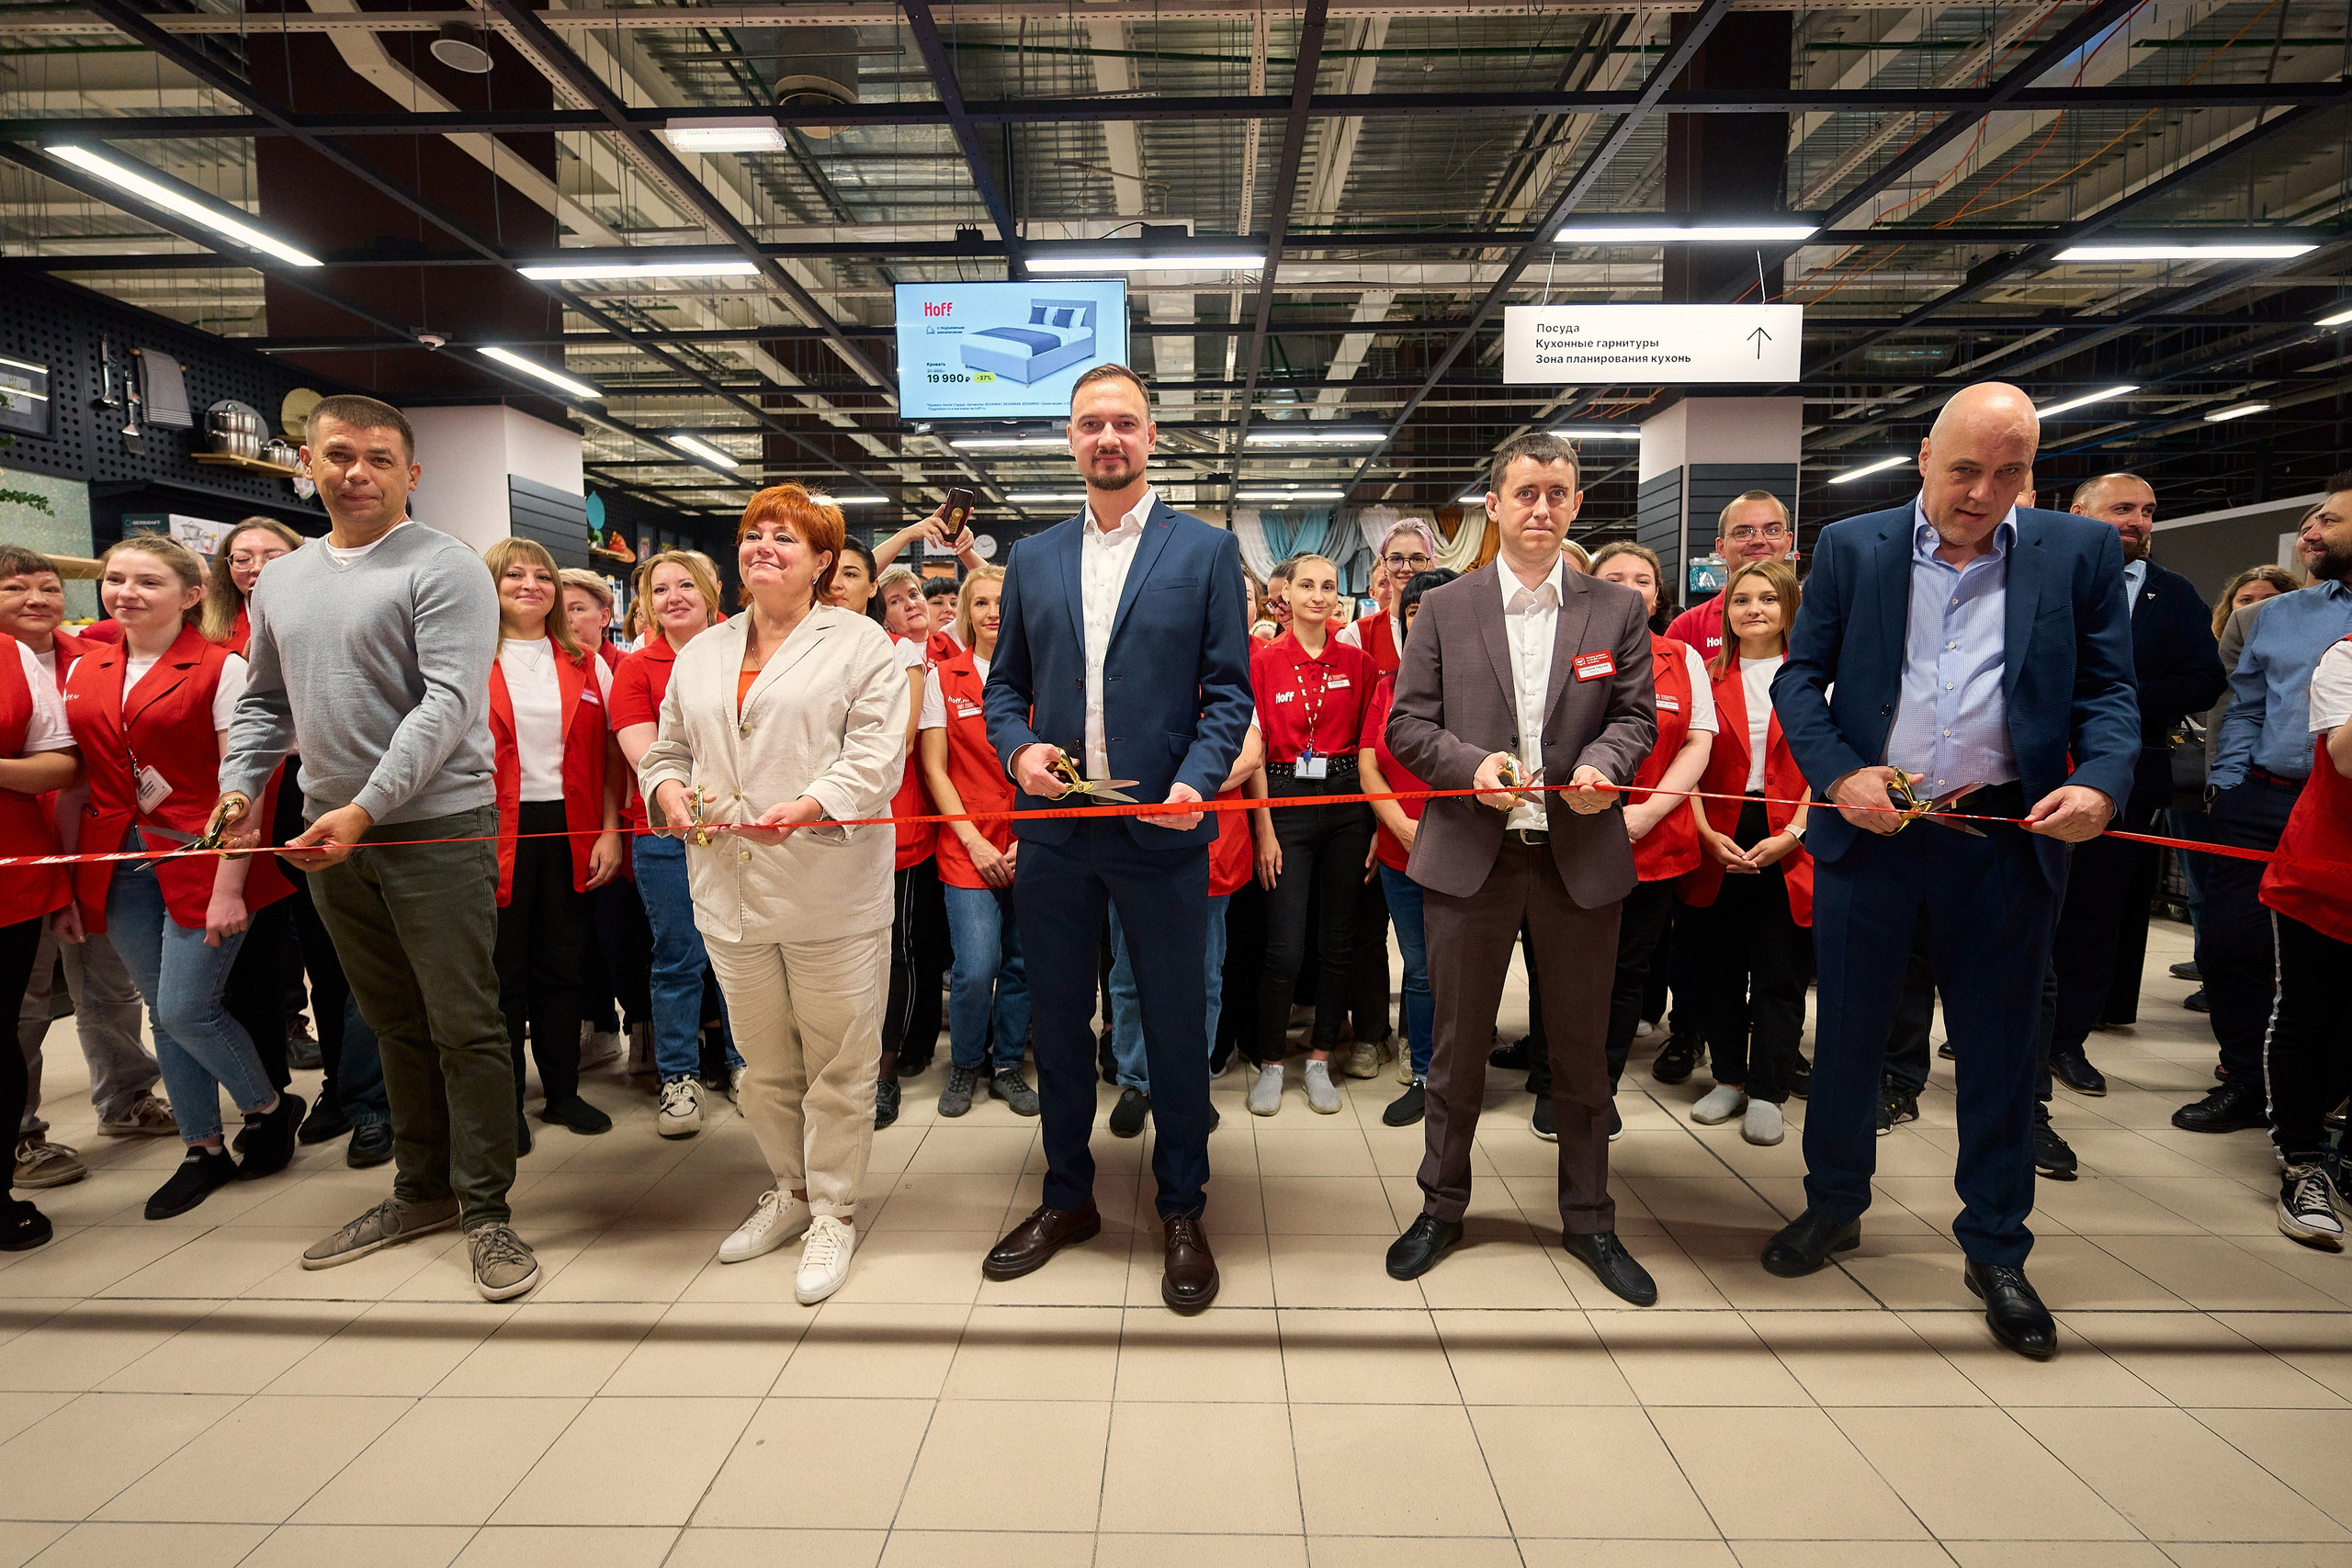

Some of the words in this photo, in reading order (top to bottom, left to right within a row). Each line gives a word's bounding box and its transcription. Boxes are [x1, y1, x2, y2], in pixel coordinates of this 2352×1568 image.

[924, 302, 953, 316] Hoff
[1536, 323, 1580, 334] Посуда
[1535, 339, 1594, 350] Кухонные
[1596, 340, 1659, 350] гарнитуры
[1535, 355, 1564, 364] Зона
[1566, 355, 1648, 365] планирования
[1651, 355, 1691, 365] кухонь
[927, 374, 939, 383] 19
[942, 374, 964, 383] 990
[1275, 691, 1295, 705] Hoff
